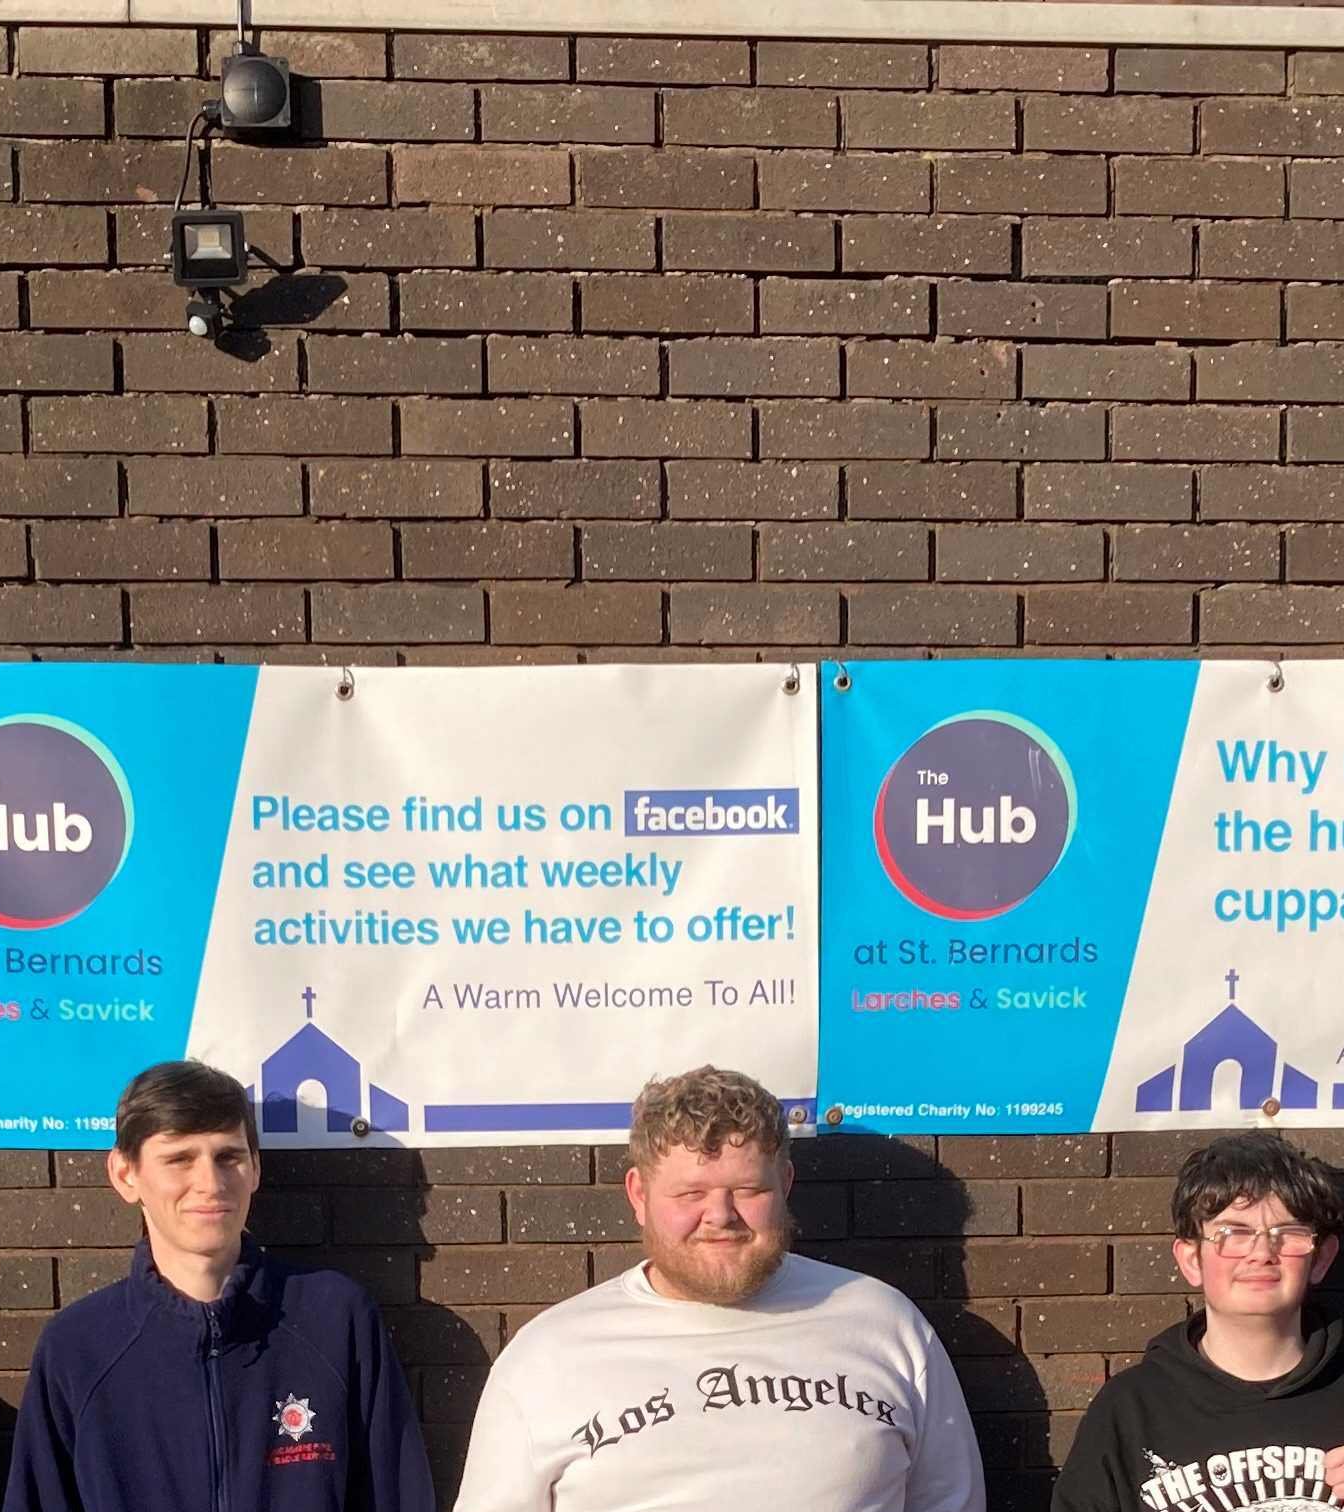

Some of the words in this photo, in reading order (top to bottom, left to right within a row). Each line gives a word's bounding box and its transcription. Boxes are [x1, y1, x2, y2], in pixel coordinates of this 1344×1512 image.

[917, 769, 949, 785] The
[1216, 739, 1326, 794] Why
[252, 795, 390, 833] Please
[402, 795, 483, 832] find
[497, 804, 547, 832] us
[560, 802, 612, 832] on
[632, 795, 788, 832] facebook
[915, 796, 1037, 845] Hub
[1214, 809, 1292, 852] the
[252, 854, 330, 889] and
[342, 860, 415, 888] see
[429, 854, 528, 888] what
[541, 852, 683, 896] weekly
[253, 909, 439, 945] activities
[451, 916, 511, 944] we
[524, 908, 622, 944] have
[633, 911, 674, 943] to
[686, 905, 797, 942] offer!
[6, 947, 163, 976] Bernards
[854, 940, 888, 965] at
[899, 940, 936, 965] St.
[948, 936, 1098, 964] Bernards
[30, 999, 50, 1021] &
[59, 999, 155, 1021] Savick
[422, 984, 444, 1009] A
[453, 983, 541, 1009] Warm
[553, 982, 693, 1008] Welcome
[704, 981, 738, 1006] To
[748, 979, 797, 1005] All!
[852, 988, 961, 1012] Larches
[969, 988, 988, 1011] &
[996, 987, 1088, 1010] Savick
[43, 1117, 69, 1130] No:
[74, 1117, 117, 1131] 11992
[918, 1102, 972, 1119] Charity
[976, 1103, 1000, 1117] No:
[1006, 1102, 1064, 1117] 1199245
[571, 1387, 676, 1458] Los
[696, 1363, 897, 1427] Angeles
[1140, 1461, 1207, 1512] THE
[1207, 1445, 1327, 1488] OFFSPR
